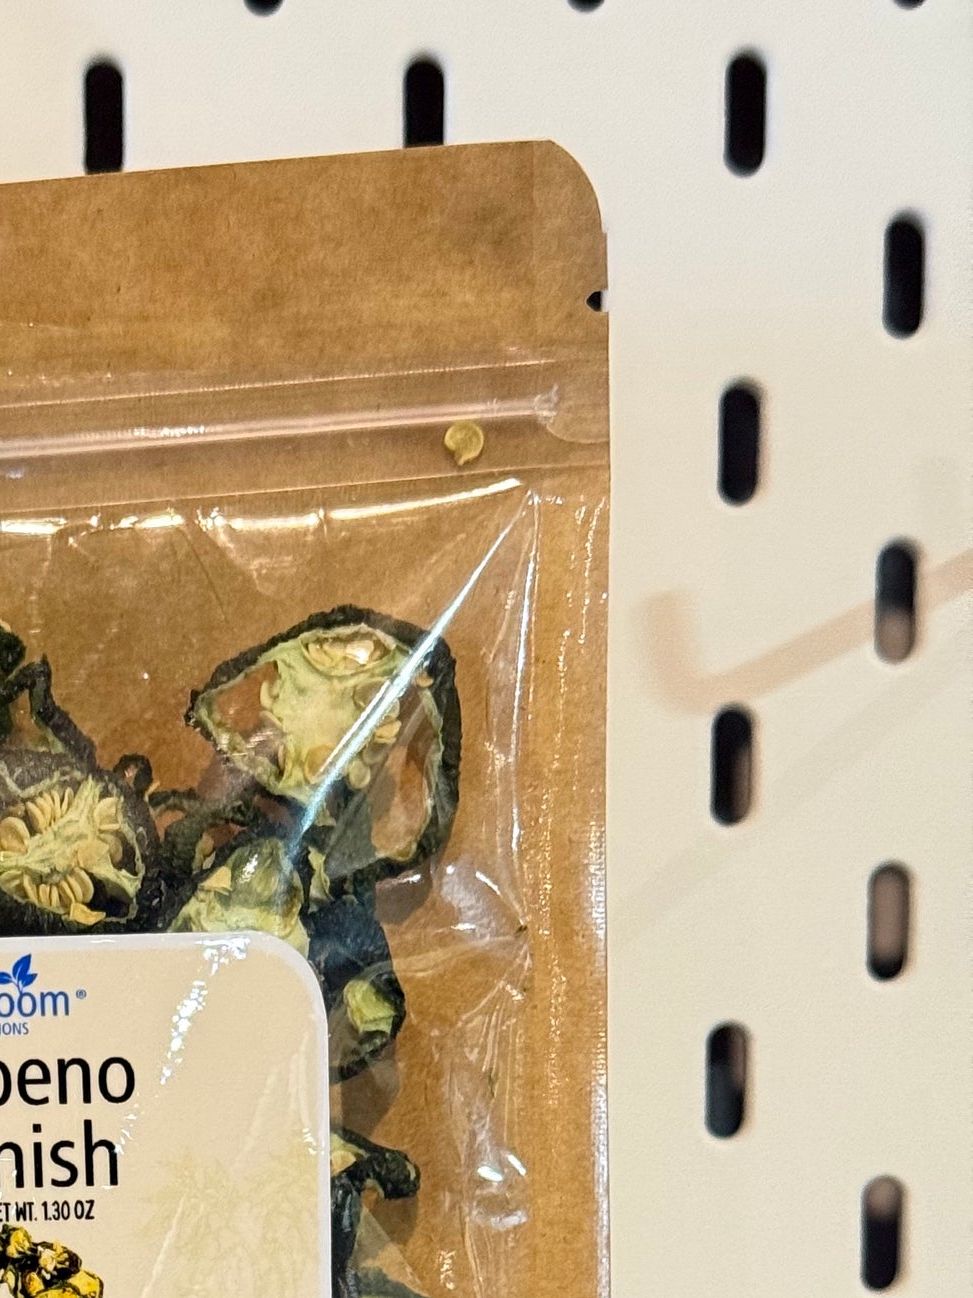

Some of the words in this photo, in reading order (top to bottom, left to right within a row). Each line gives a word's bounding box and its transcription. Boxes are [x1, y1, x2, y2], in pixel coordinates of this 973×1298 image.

[15, 1201, 38, 1222] WT.
[41, 1200, 70, 1222] 1.30
[74, 1199, 95, 1221] OZ
